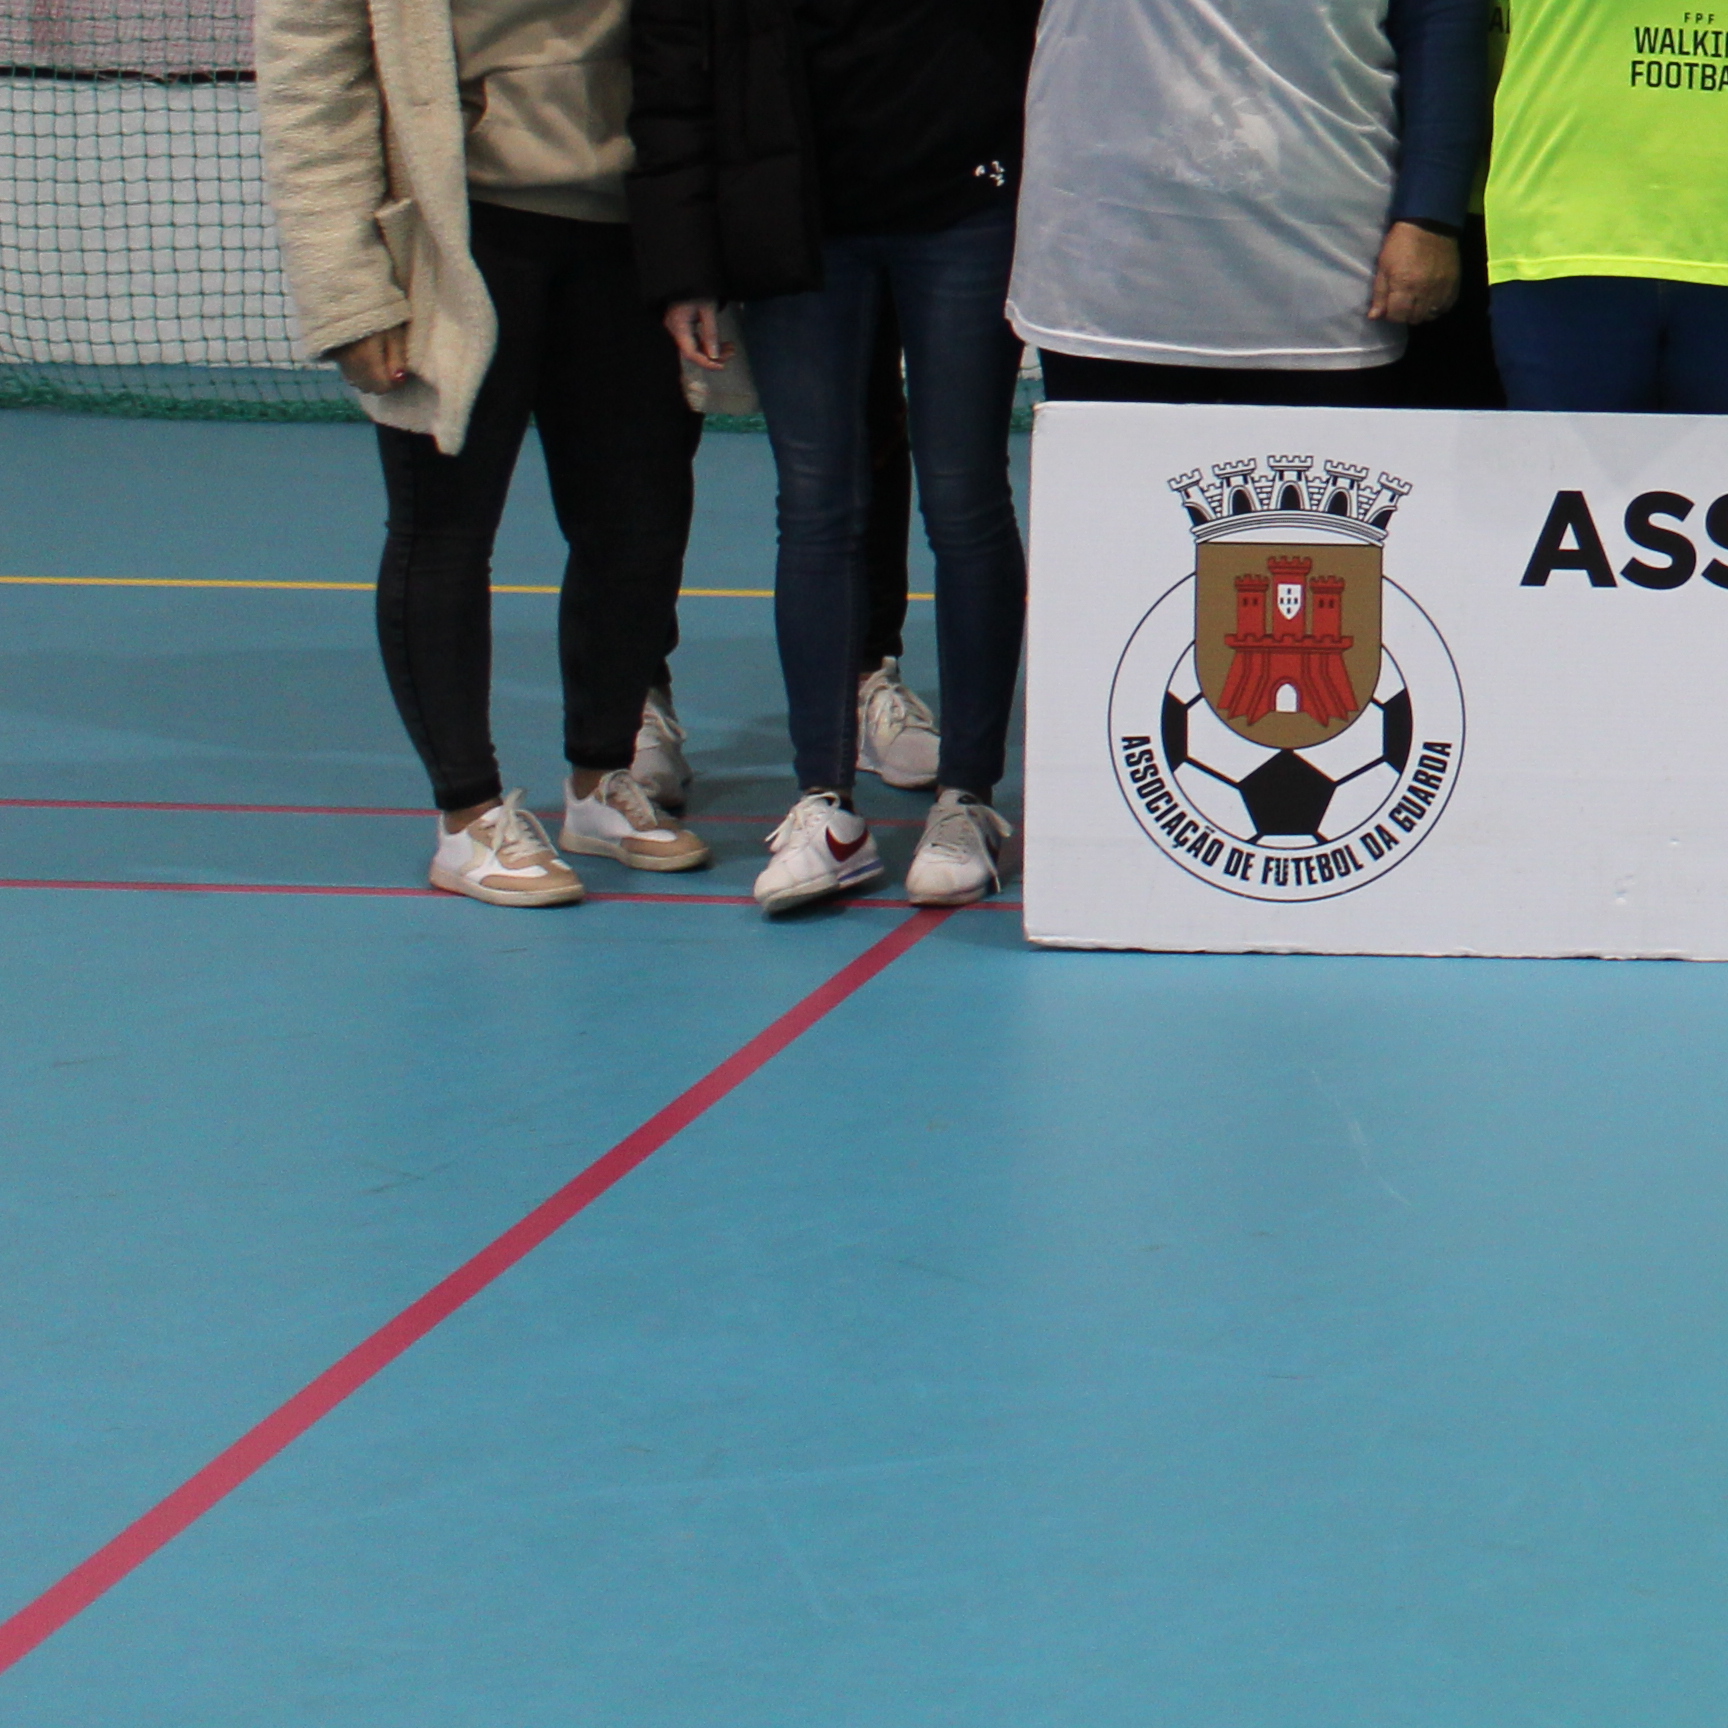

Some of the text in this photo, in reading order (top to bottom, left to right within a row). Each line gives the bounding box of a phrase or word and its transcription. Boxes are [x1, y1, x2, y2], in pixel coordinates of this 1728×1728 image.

[1122, 736, 1453, 886] ASSOCIAÇÃO DE FUTEBOL DA GUARDA
